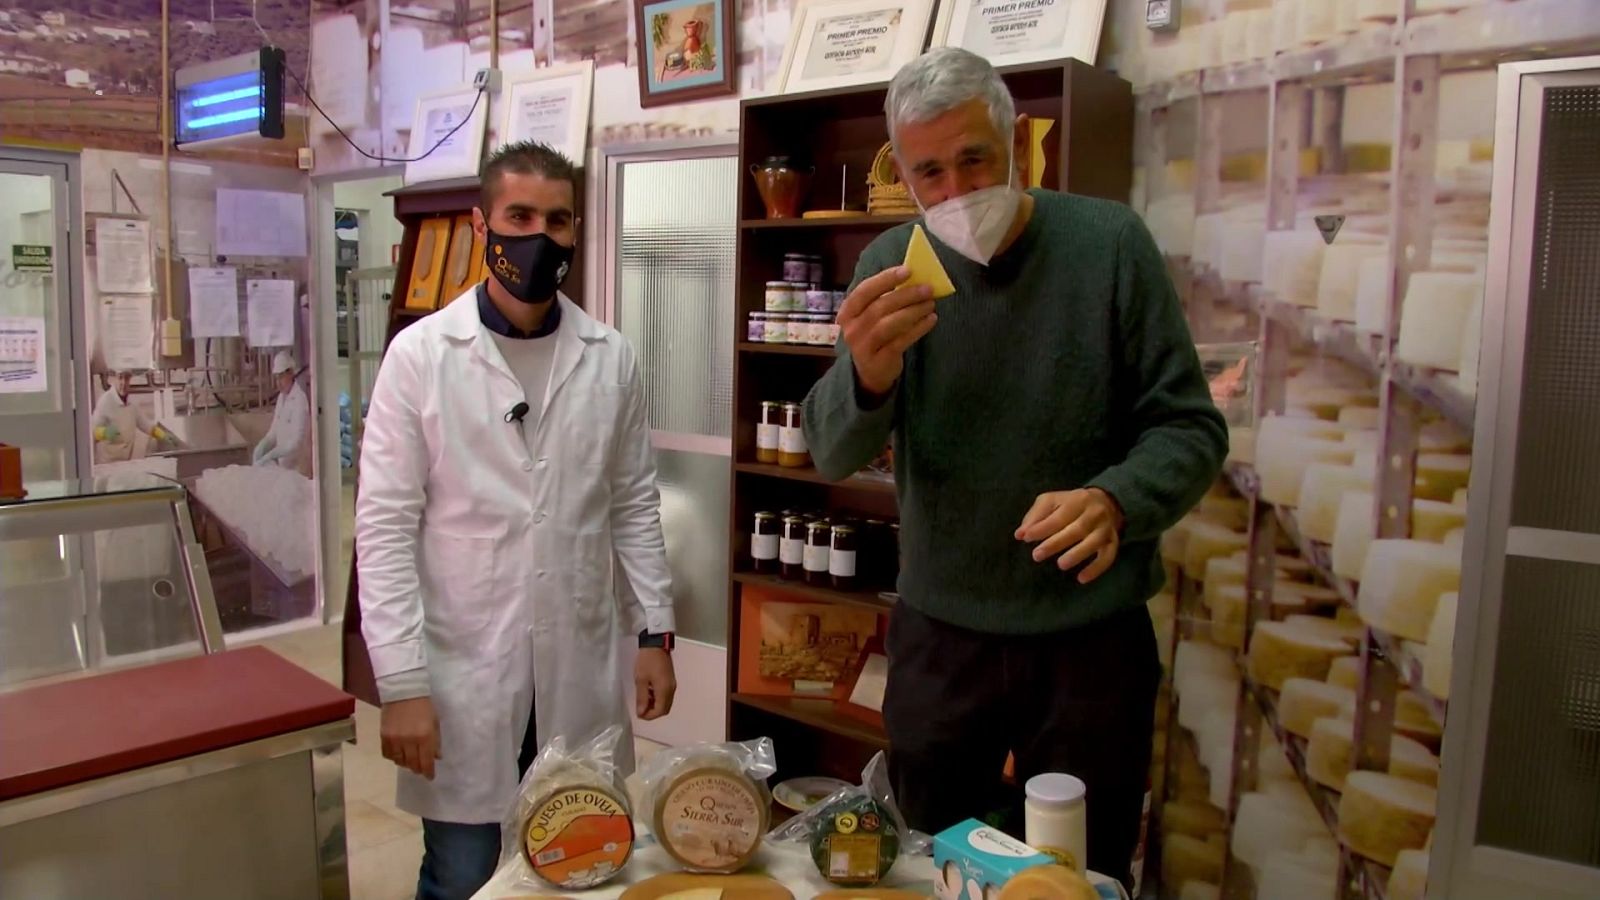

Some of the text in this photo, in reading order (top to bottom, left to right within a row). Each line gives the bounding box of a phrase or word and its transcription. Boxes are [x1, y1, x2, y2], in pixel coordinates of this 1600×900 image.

[982, 0, 1054, 15] PRIMER PREMIO
[827, 26, 888, 40] PRIMER PREMIO
[530, 799, 564, 841] QUESO
[565, 793, 581, 806] DE
